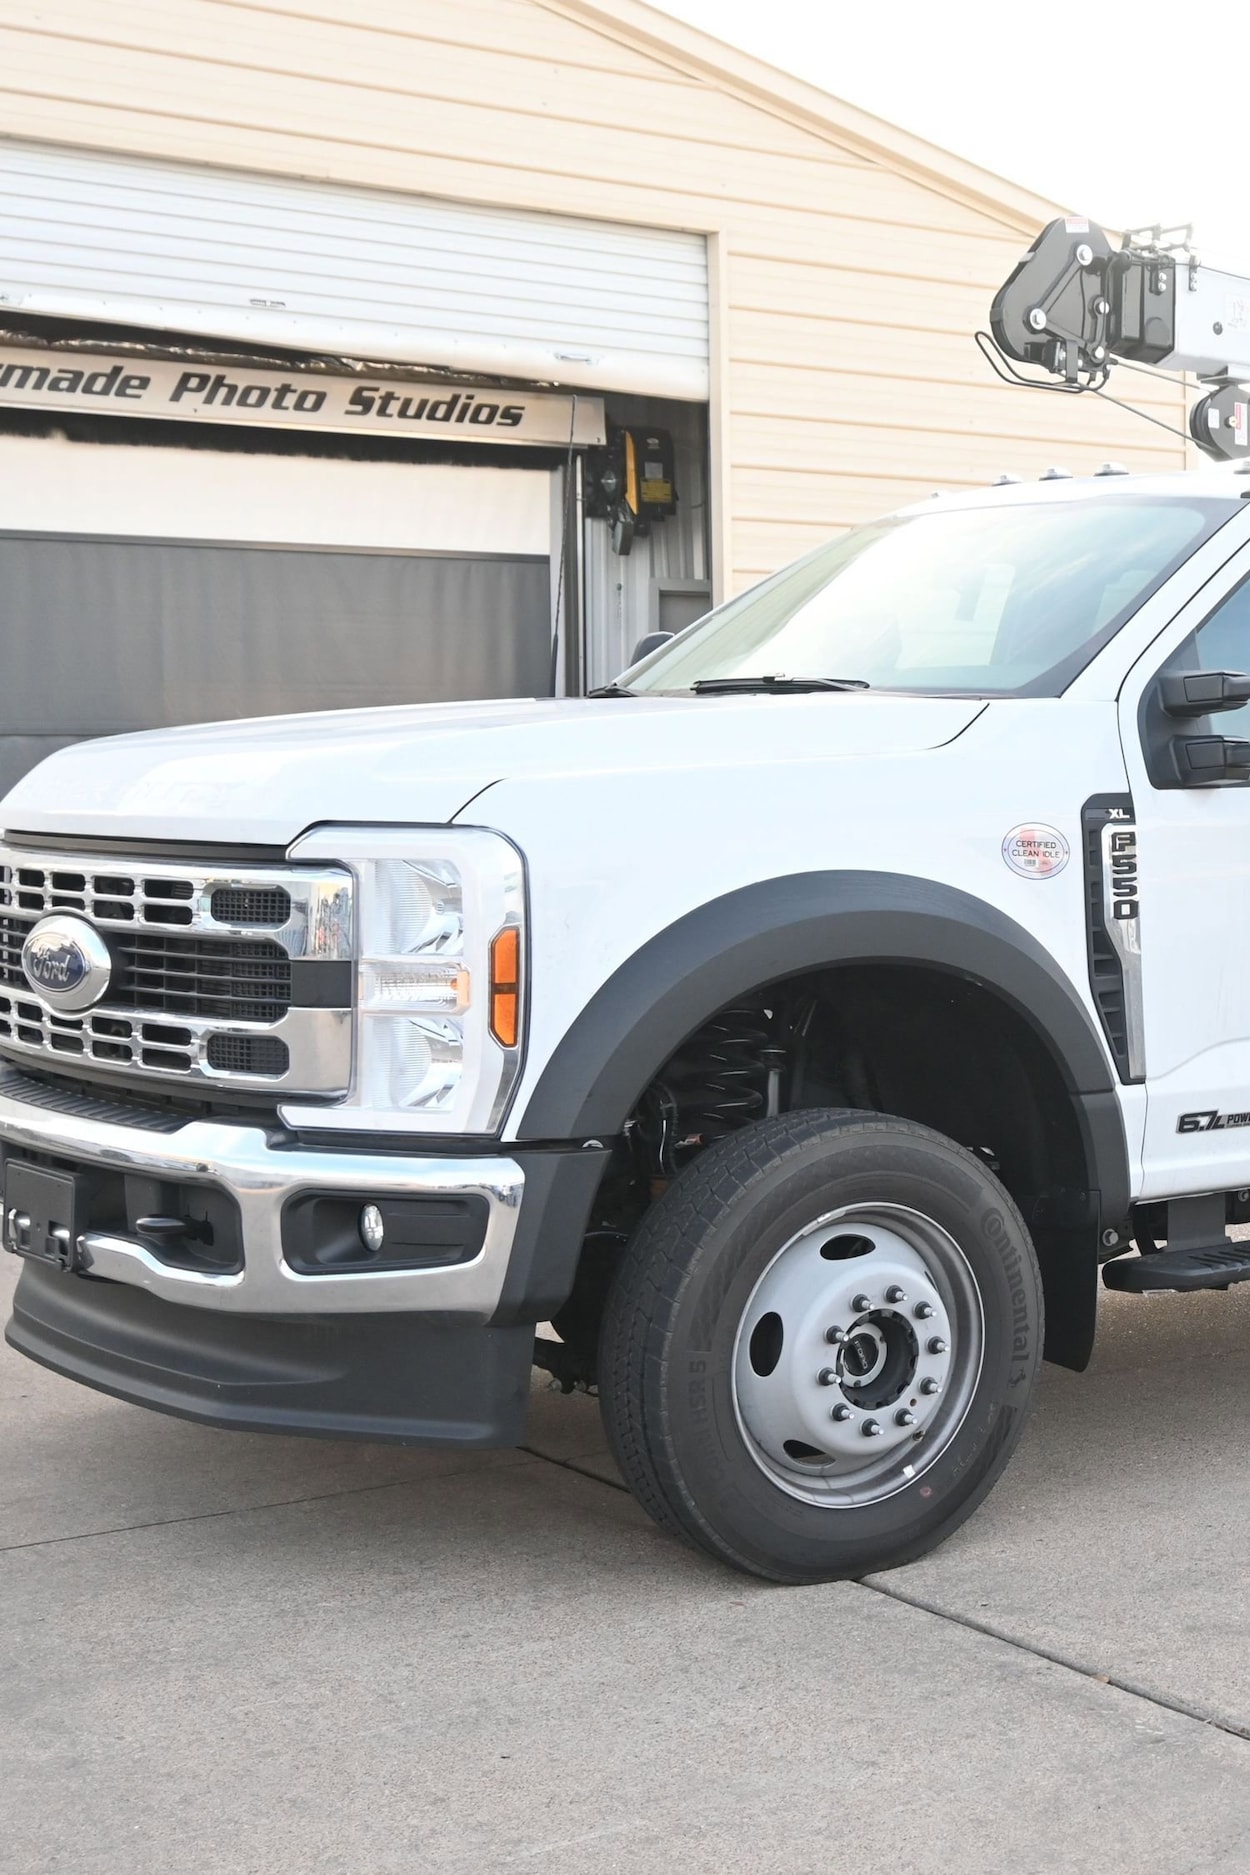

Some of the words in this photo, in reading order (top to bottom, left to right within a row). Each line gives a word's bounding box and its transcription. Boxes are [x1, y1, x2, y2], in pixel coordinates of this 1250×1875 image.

[0, 363, 151, 399] made
[169, 371, 327, 412] Photo
[344, 386, 526, 427] Studios
[1108, 808, 1130, 819] XL
[1011, 849, 1039, 857] CLEAN
[1042, 850, 1060, 858] IDLE
[1015, 839, 1057, 849] CERTIFIED
[1111, 831, 1138, 920] F550
[31, 944, 71, 982] Ford
[1178, 1109, 1226, 1133] 6.7L
[980, 1208, 1031, 1362] Continental
[688, 1360, 707, 1374] 5
